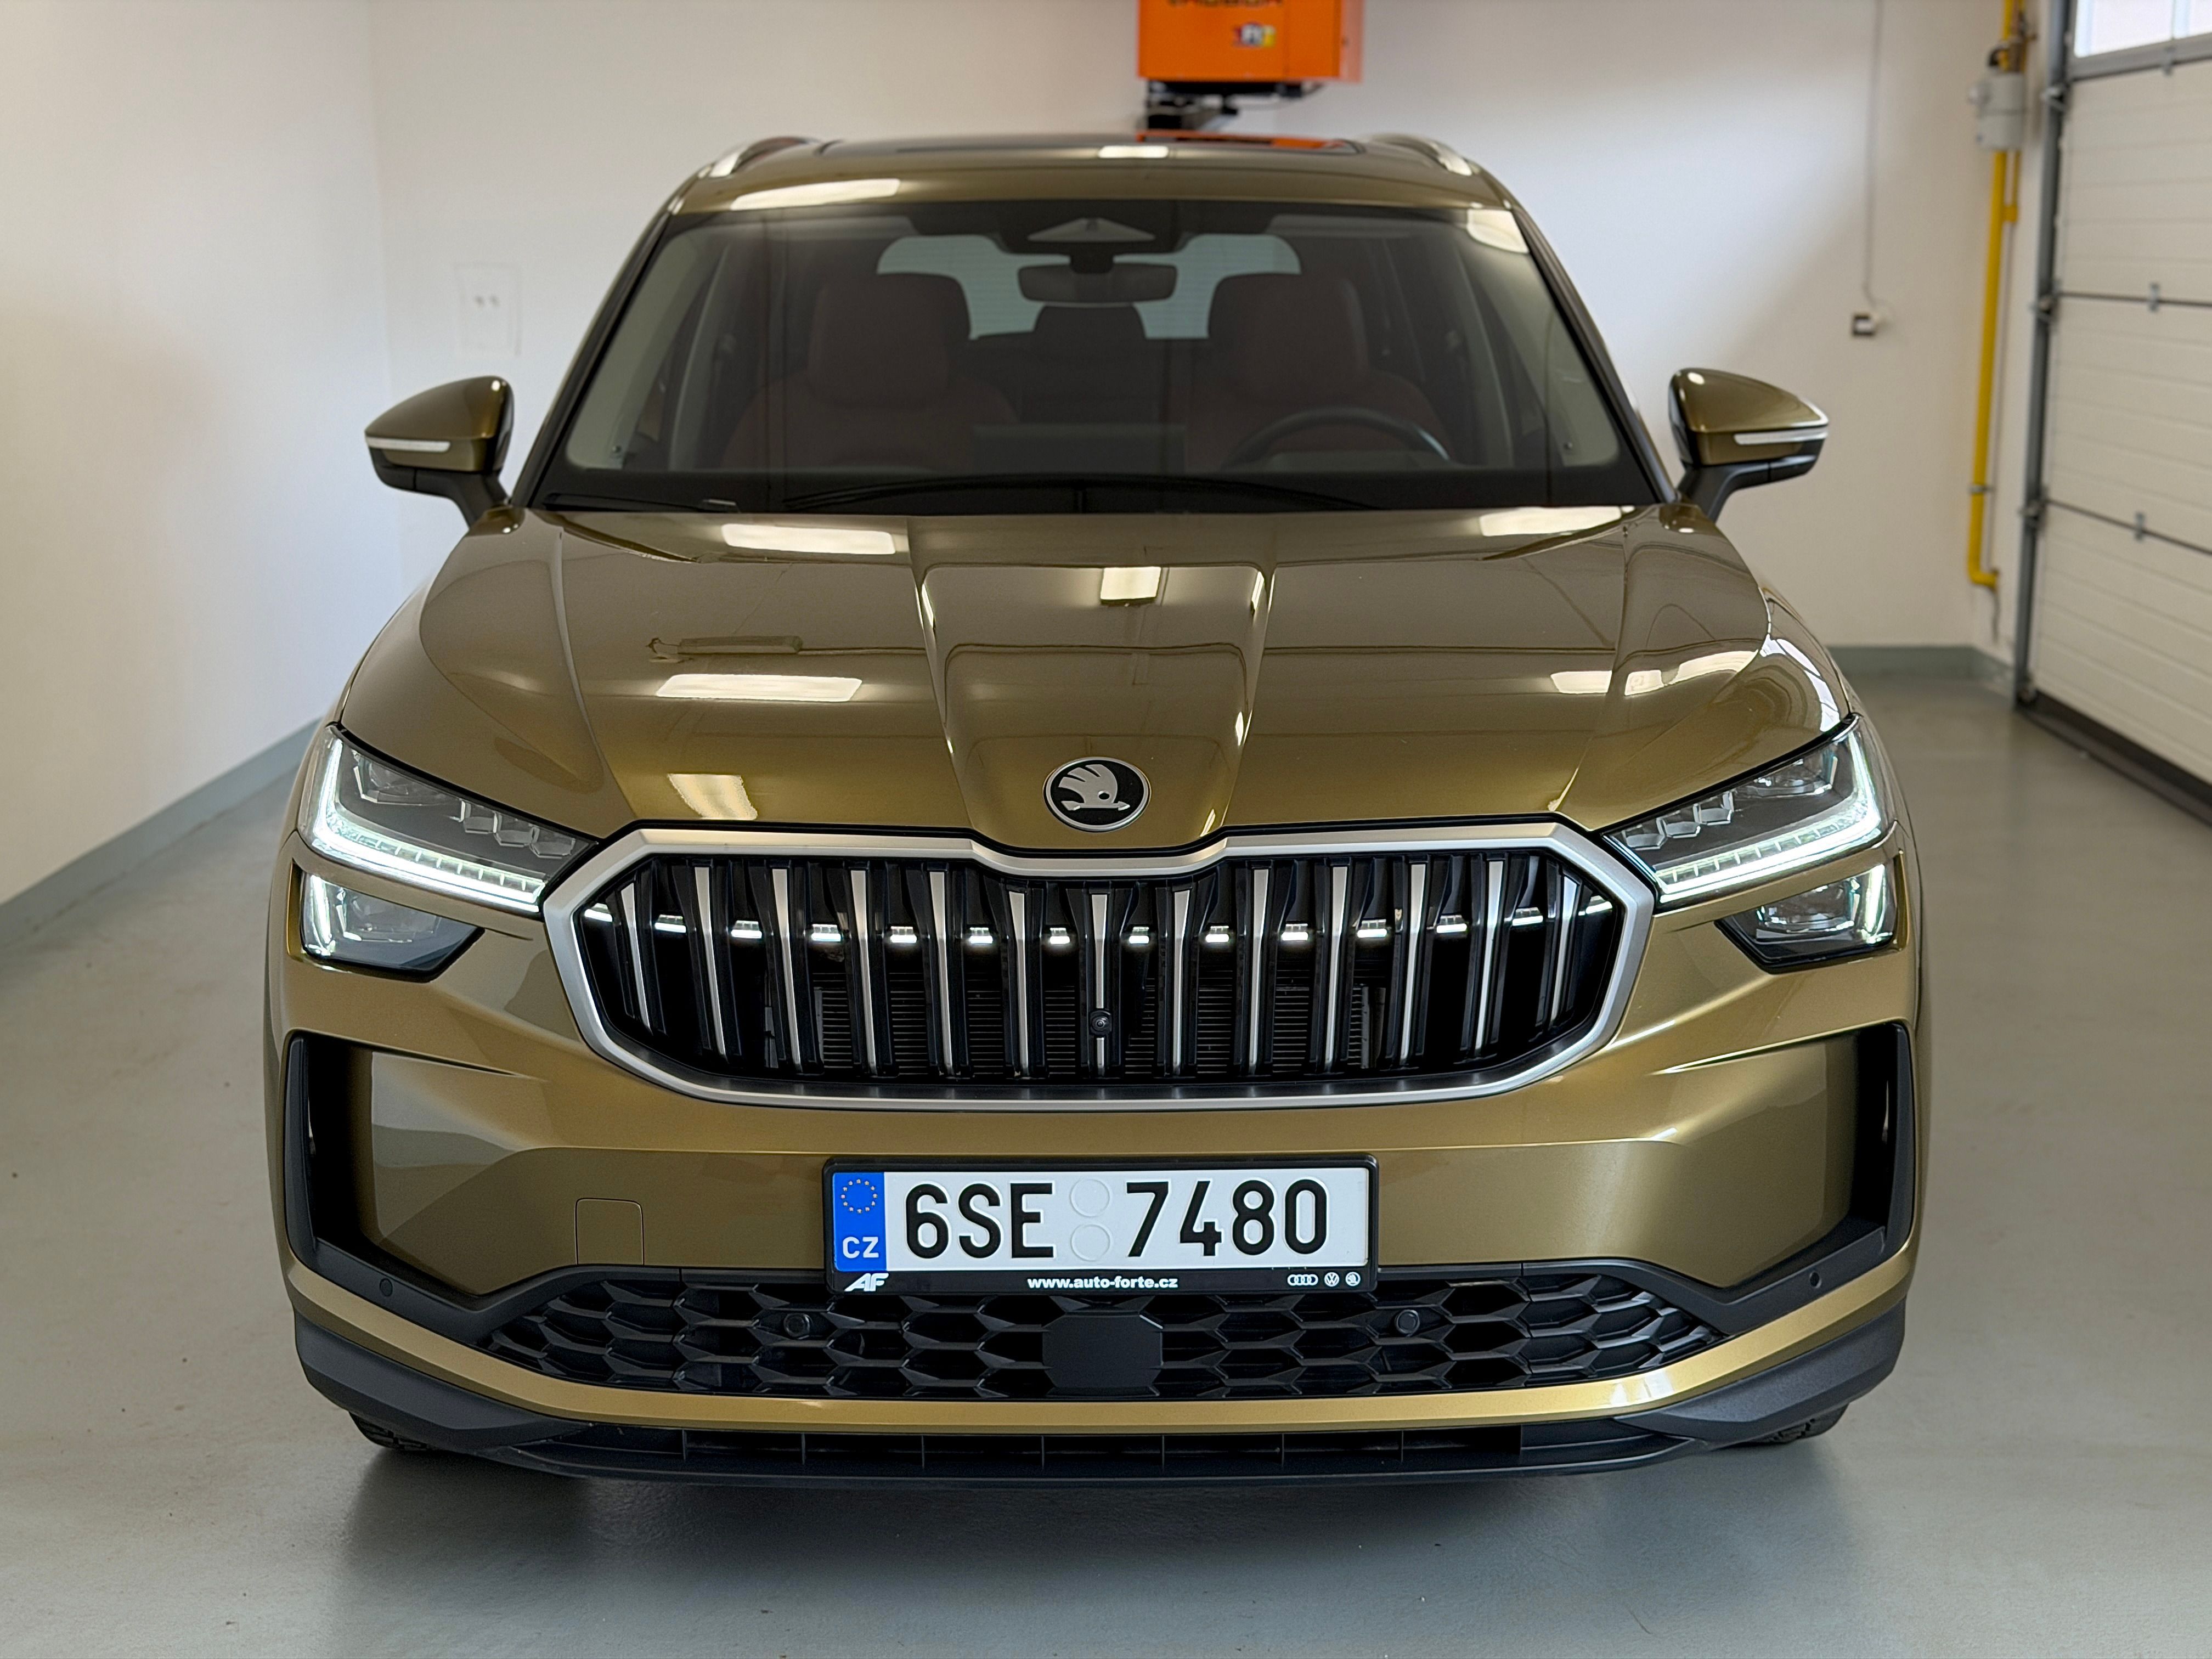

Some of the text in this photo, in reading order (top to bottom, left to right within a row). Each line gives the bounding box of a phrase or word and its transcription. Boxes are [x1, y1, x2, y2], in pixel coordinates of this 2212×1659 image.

[906, 1180, 1327, 1259] 6SE 7480
[842, 1236, 879, 1259] CZ
[844, 1273, 889, 1292] AF
[1028, 1276, 1178, 1288] www.auto-forte.cz
